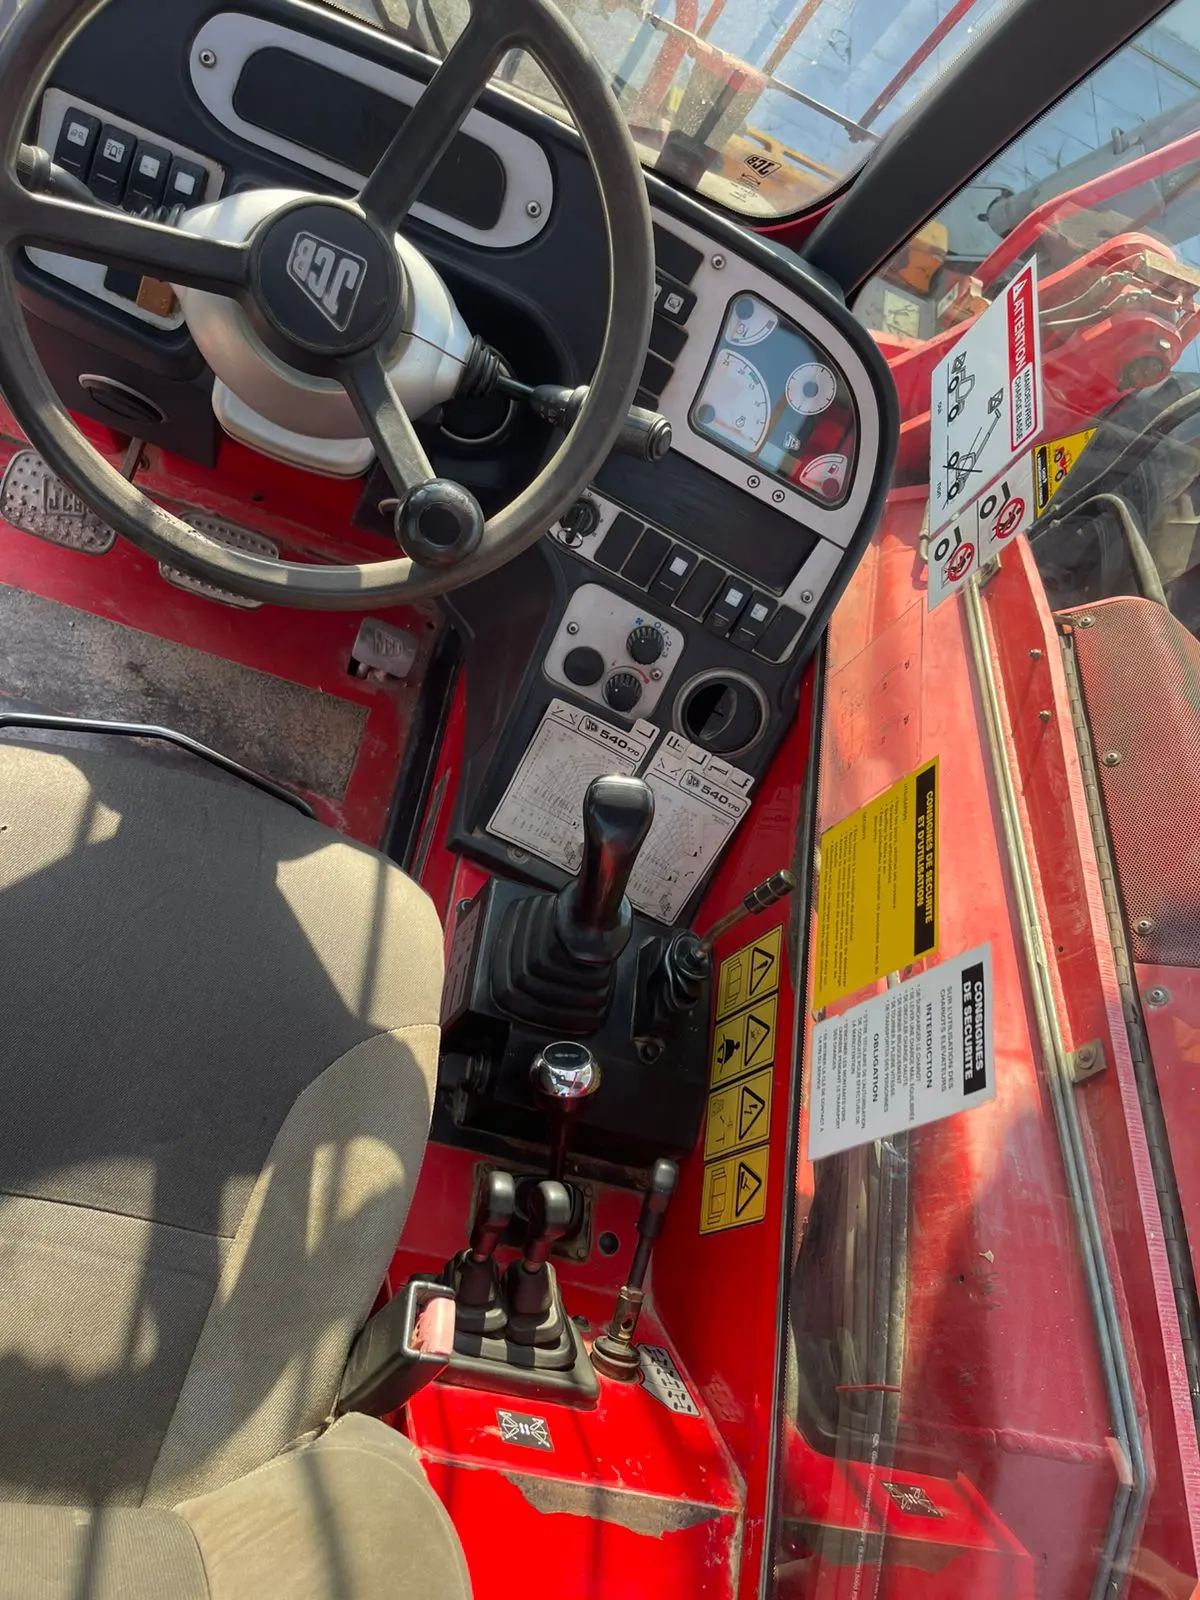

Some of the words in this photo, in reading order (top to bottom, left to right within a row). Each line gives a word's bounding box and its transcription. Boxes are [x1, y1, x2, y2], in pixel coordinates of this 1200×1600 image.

[293, 238, 360, 315] JCB
[1013, 294, 1025, 373] ATTENTION
[1023, 367, 1031, 430] MANOEUVRER
[600, 729, 628, 749] 540
[627, 747, 640, 757] 170
[701, 785, 729, 804] 540
[728, 802, 740, 813] 170
[917, 813, 924, 829] ET
[925, 788, 933, 852] CONSIGNES
[916, 828, 924, 908] D'UTILISATION
[925, 851, 932, 869] DE
[924, 868, 932, 925] SECURITE
[963, 980, 971, 1002] DE
[963, 1004, 972, 1080] SECURITE
[974, 979, 983, 1071] CONSIGNES
